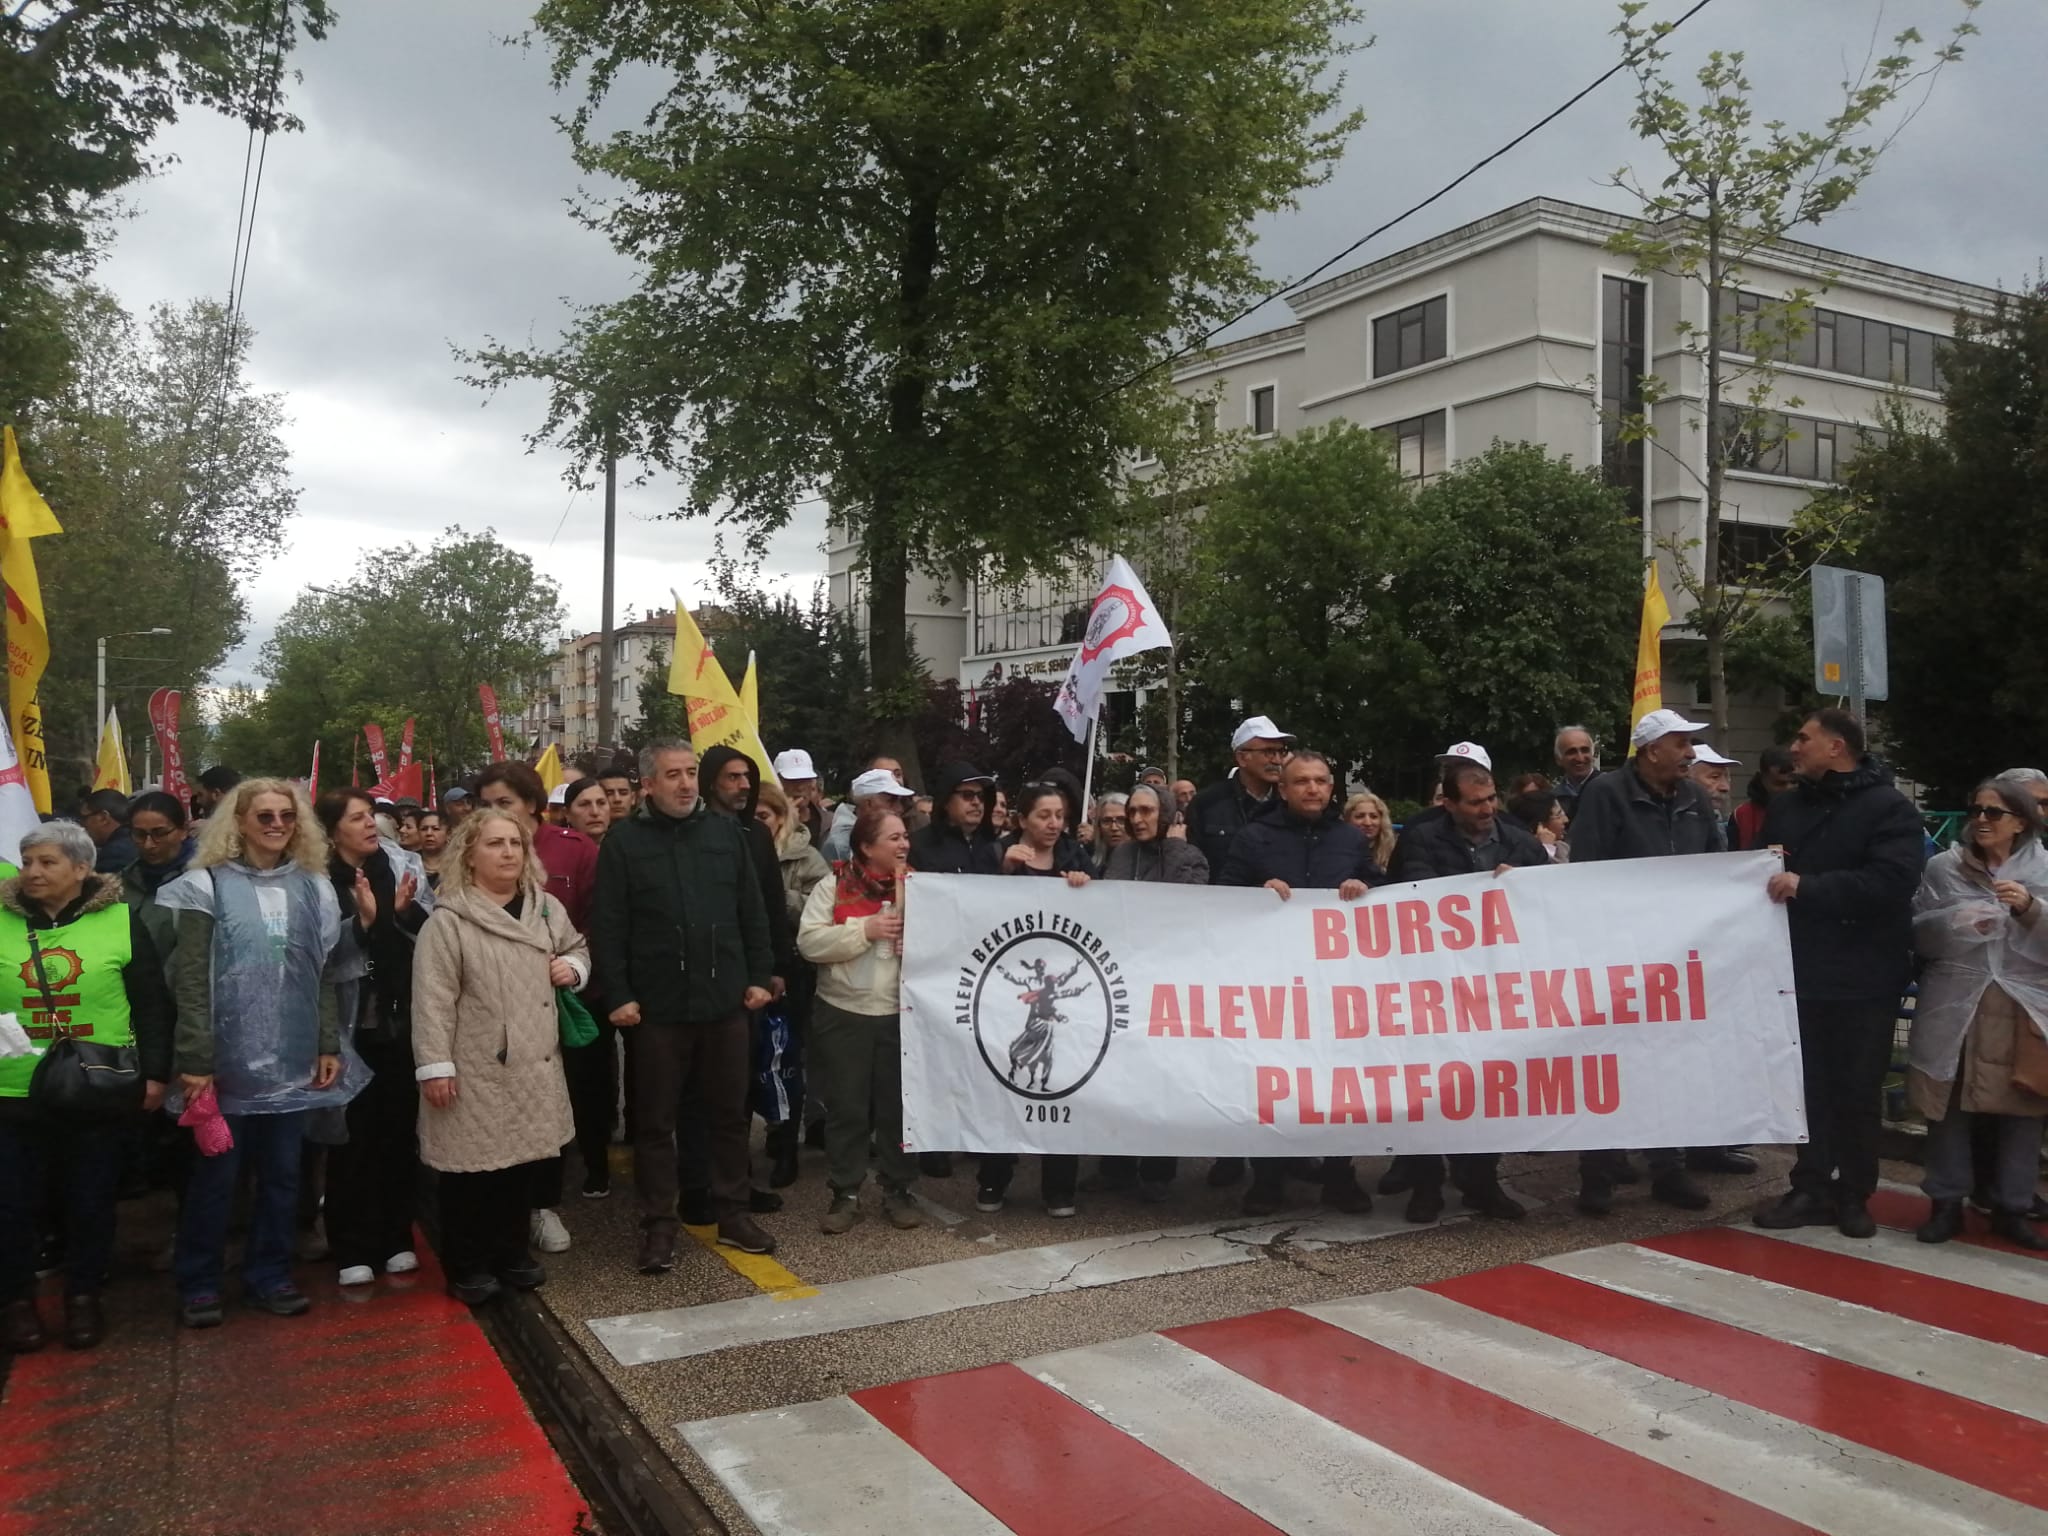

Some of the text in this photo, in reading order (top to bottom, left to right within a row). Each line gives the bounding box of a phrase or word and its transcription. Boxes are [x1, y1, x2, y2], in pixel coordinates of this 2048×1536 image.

[1312, 889, 1520, 960] BURSA
[955, 910, 1130, 1029] ALEVİ BEKTAŞİ FEDERASYONU
[1148, 950, 1707, 1040] ALEVİ DERNEKLERİ
[1025, 1104, 1071, 1124] 2002
[1256, 1054, 1620, 1125] PLATFORMU
